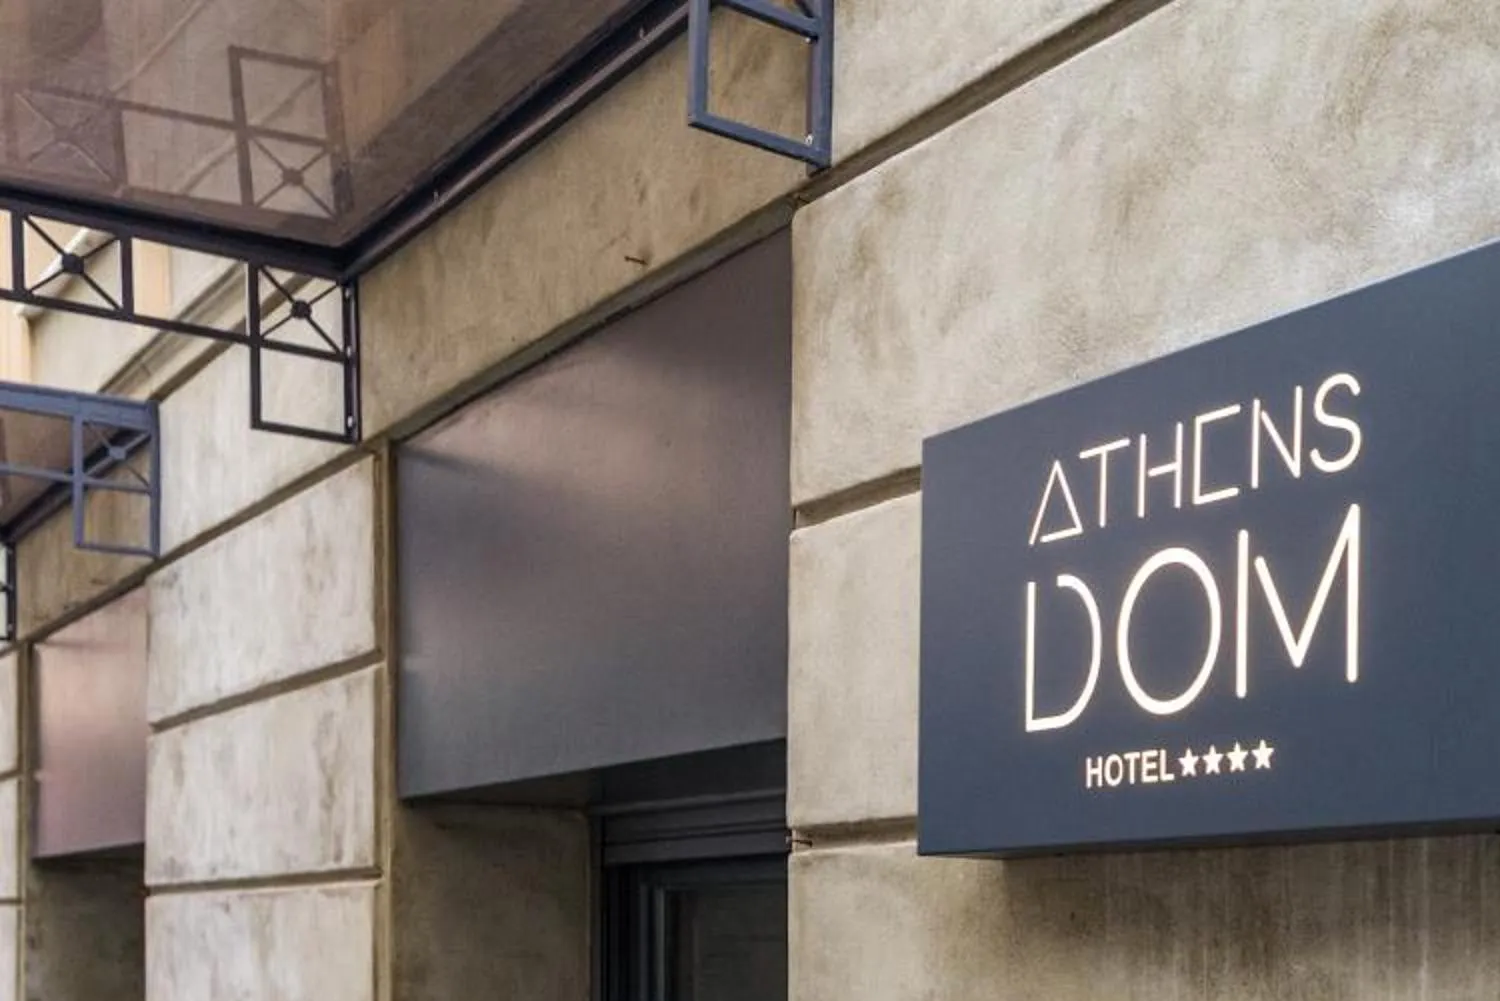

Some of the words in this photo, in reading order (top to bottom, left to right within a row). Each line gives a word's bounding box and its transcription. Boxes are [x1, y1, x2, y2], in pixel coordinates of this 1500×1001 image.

[1029, 372, 1363, 546] ATHENS
[1025, 502, 1361, 733] DOM
[1085, 748, 1176, 789] HOTEL
